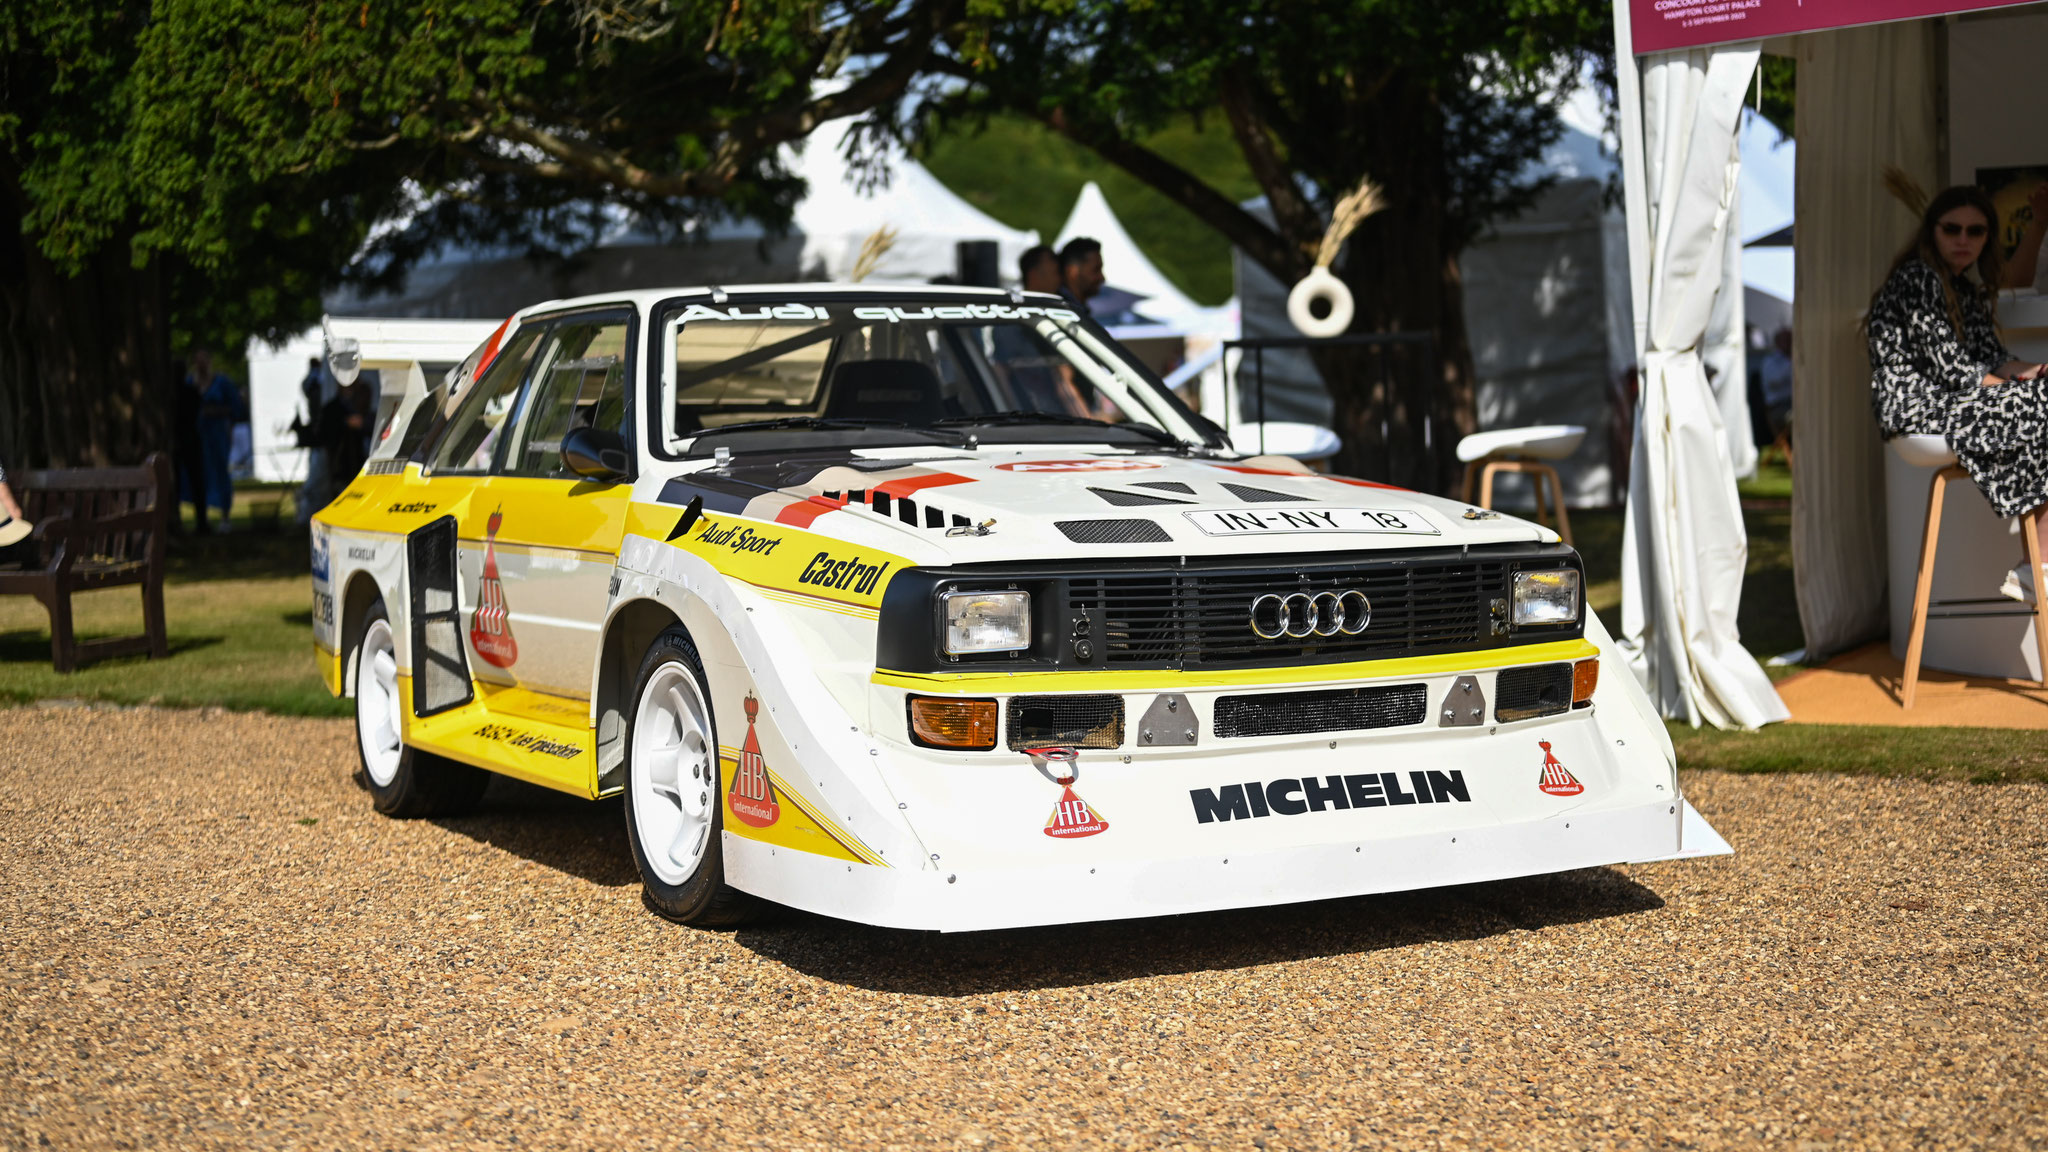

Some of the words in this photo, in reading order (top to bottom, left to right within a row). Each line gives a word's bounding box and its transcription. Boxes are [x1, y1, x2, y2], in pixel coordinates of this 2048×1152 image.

[1663, 8, 1703, 20] HAMPTON
[1703, 3, 1730, 14] COURT
[1731, 0, 1761, 10] PALACE
[675, 303, 830, 322] Audi
[853, 304, 1080, 323] quattro
[1214, 511, 1339, 531] IN-NY
[1361, 511, 1408, 529] 18
[695, 522, 742, 546] Audi
[732, 527, 783, 556] Sport
[798, 551, 890, 596] Castrol
[739, 749, 766, 802] HB
[1542, 762, 1571, 786] HB
[1189, 769, 1472, 824] MICHELIN
[734, 798, 773, 821] international
[1054, 798, 1091, 827] HB
[1051, 823, 1102, 836] international
